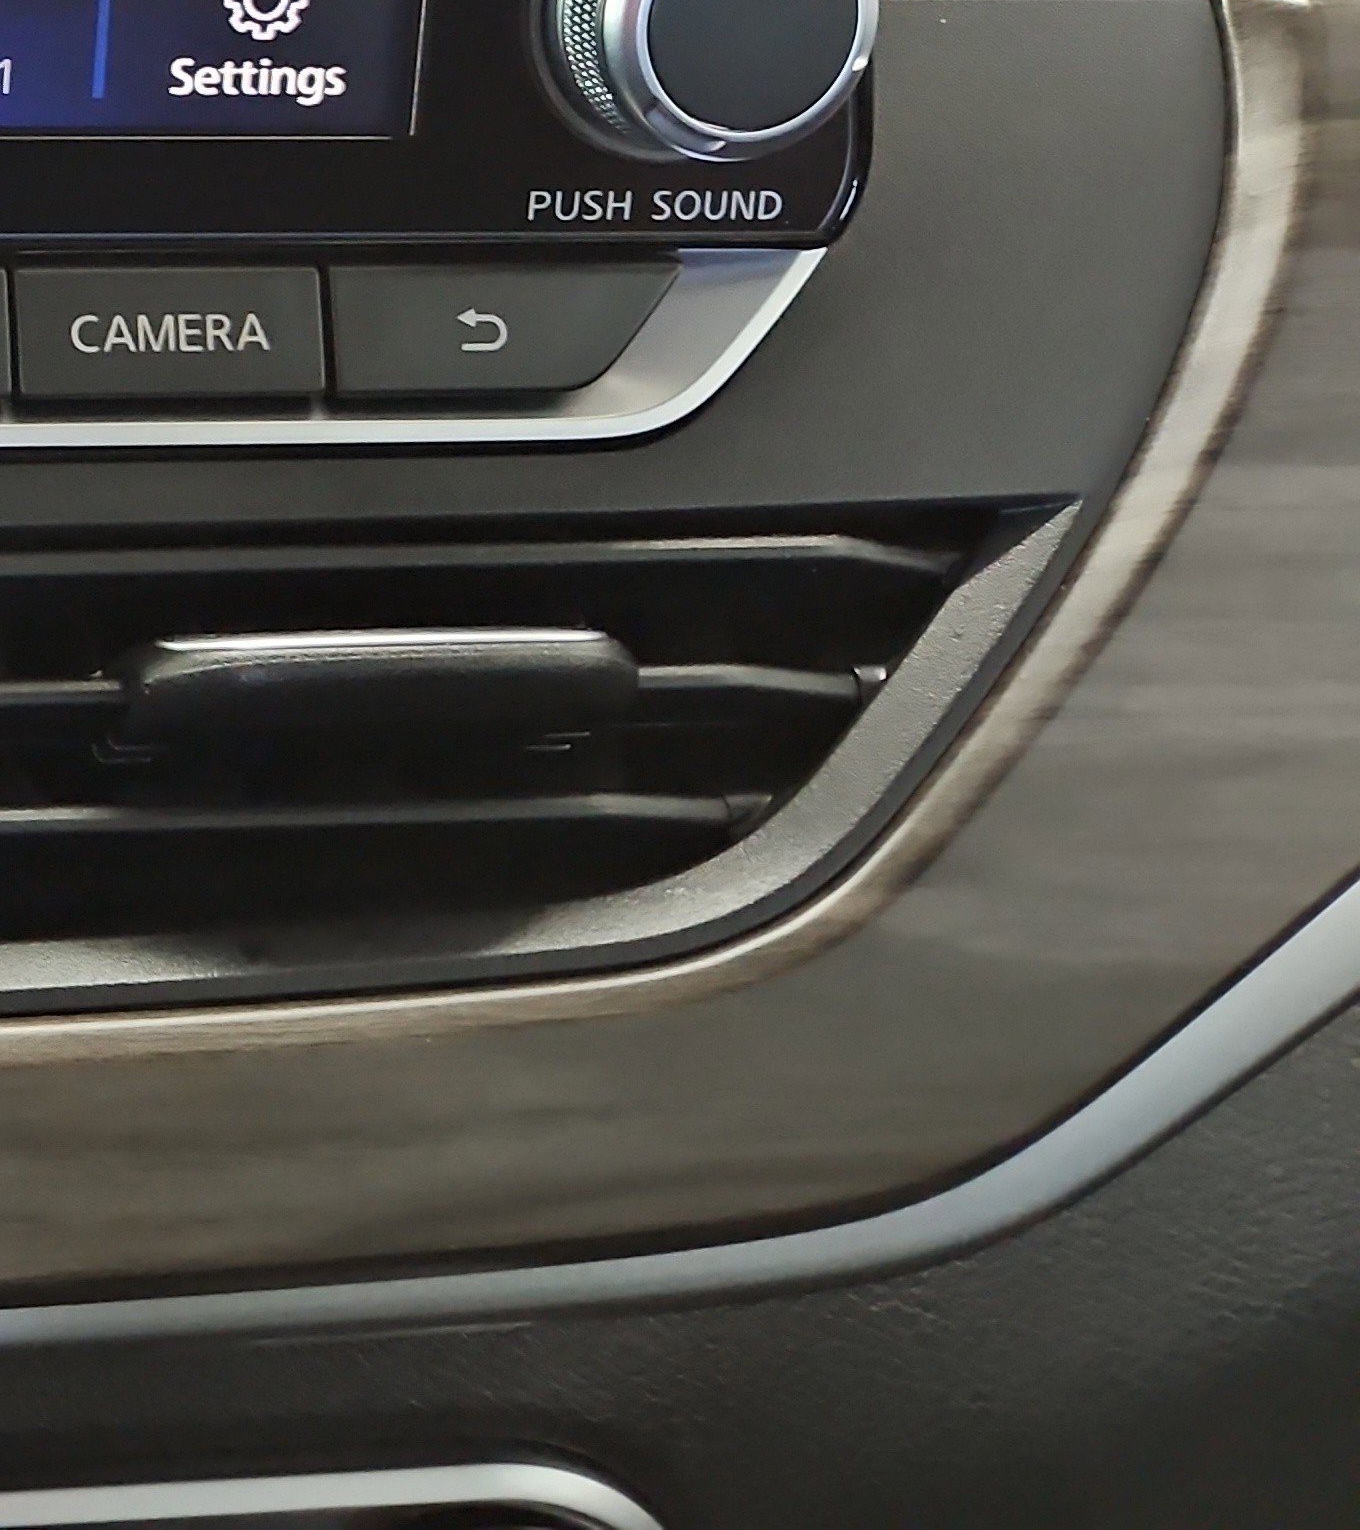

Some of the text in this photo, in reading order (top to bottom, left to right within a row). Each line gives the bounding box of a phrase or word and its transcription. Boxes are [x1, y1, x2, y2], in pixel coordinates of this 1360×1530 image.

[167, 57, 347, 107] Settings
[527, 190, 783, 221] PUSH SOUND
[70, 313, 271, 353] CAMERA
